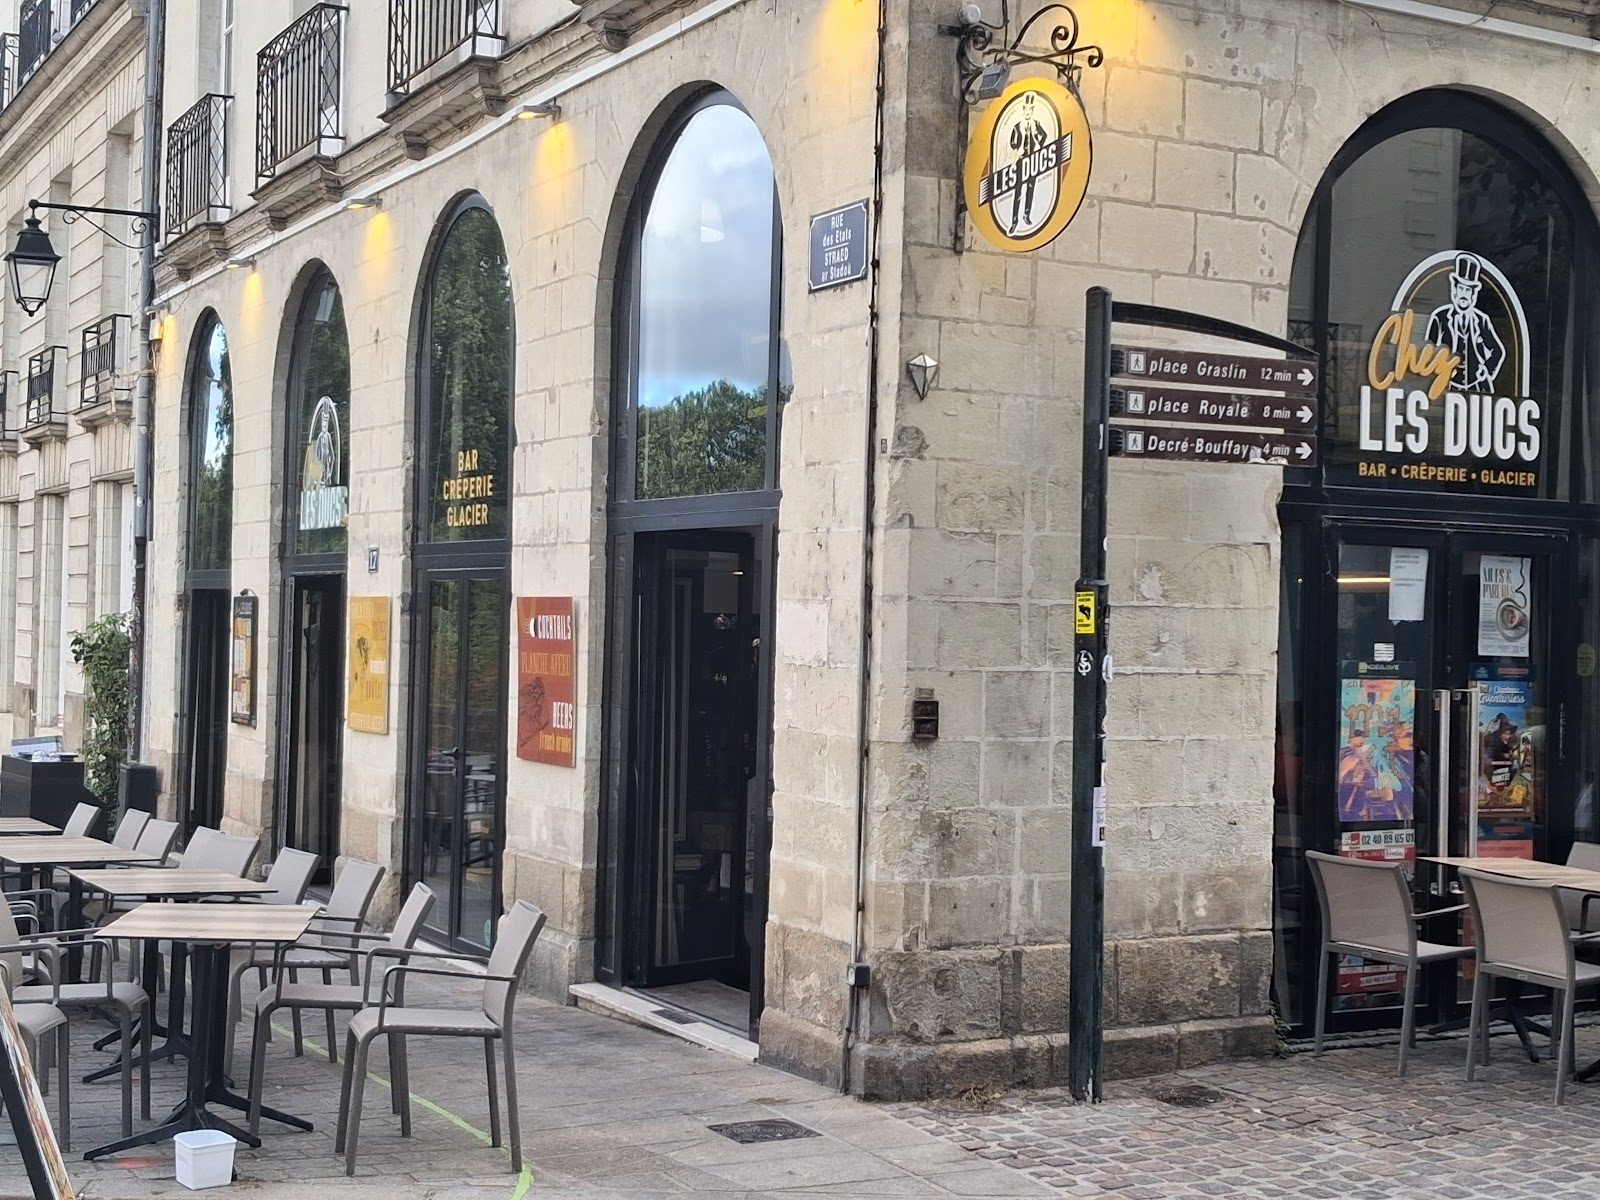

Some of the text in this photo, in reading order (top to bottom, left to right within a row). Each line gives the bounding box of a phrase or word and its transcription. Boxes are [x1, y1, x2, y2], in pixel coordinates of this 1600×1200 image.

[993, 144, 1057, 196] LES DUCS
[831, 213, 844, 229] RUE
[822, 233, 833, 247] des
[824, 247, 849, 266] STRAED
[821, 271, 829, 282] ar
[1368, 308, 1461, 400] Chez
[1149, 357, 1292, 382] place Graslin 12 min
[1147, 396, 1291, 419] place Royale 8 min
[1359, 385, 1541, 462] LES DUCS
[1147, 435, 1290, 459] Decré-Bouffay 4 min
[458, 449, 478, 472] BAR
[443, 472, 493, 500] CRÊPERIE
[1358, 462, 1536, 486] BAR CRÊPERIE GLACIER
[301, 486, 341, 530] LES DUCS
[447, 503, 488, 527] GLACIER
[369, 551, 378, 571] 17
[537, 614, 571, 640] COCKTAILS
[552, 701, 573, 729] BEERS
